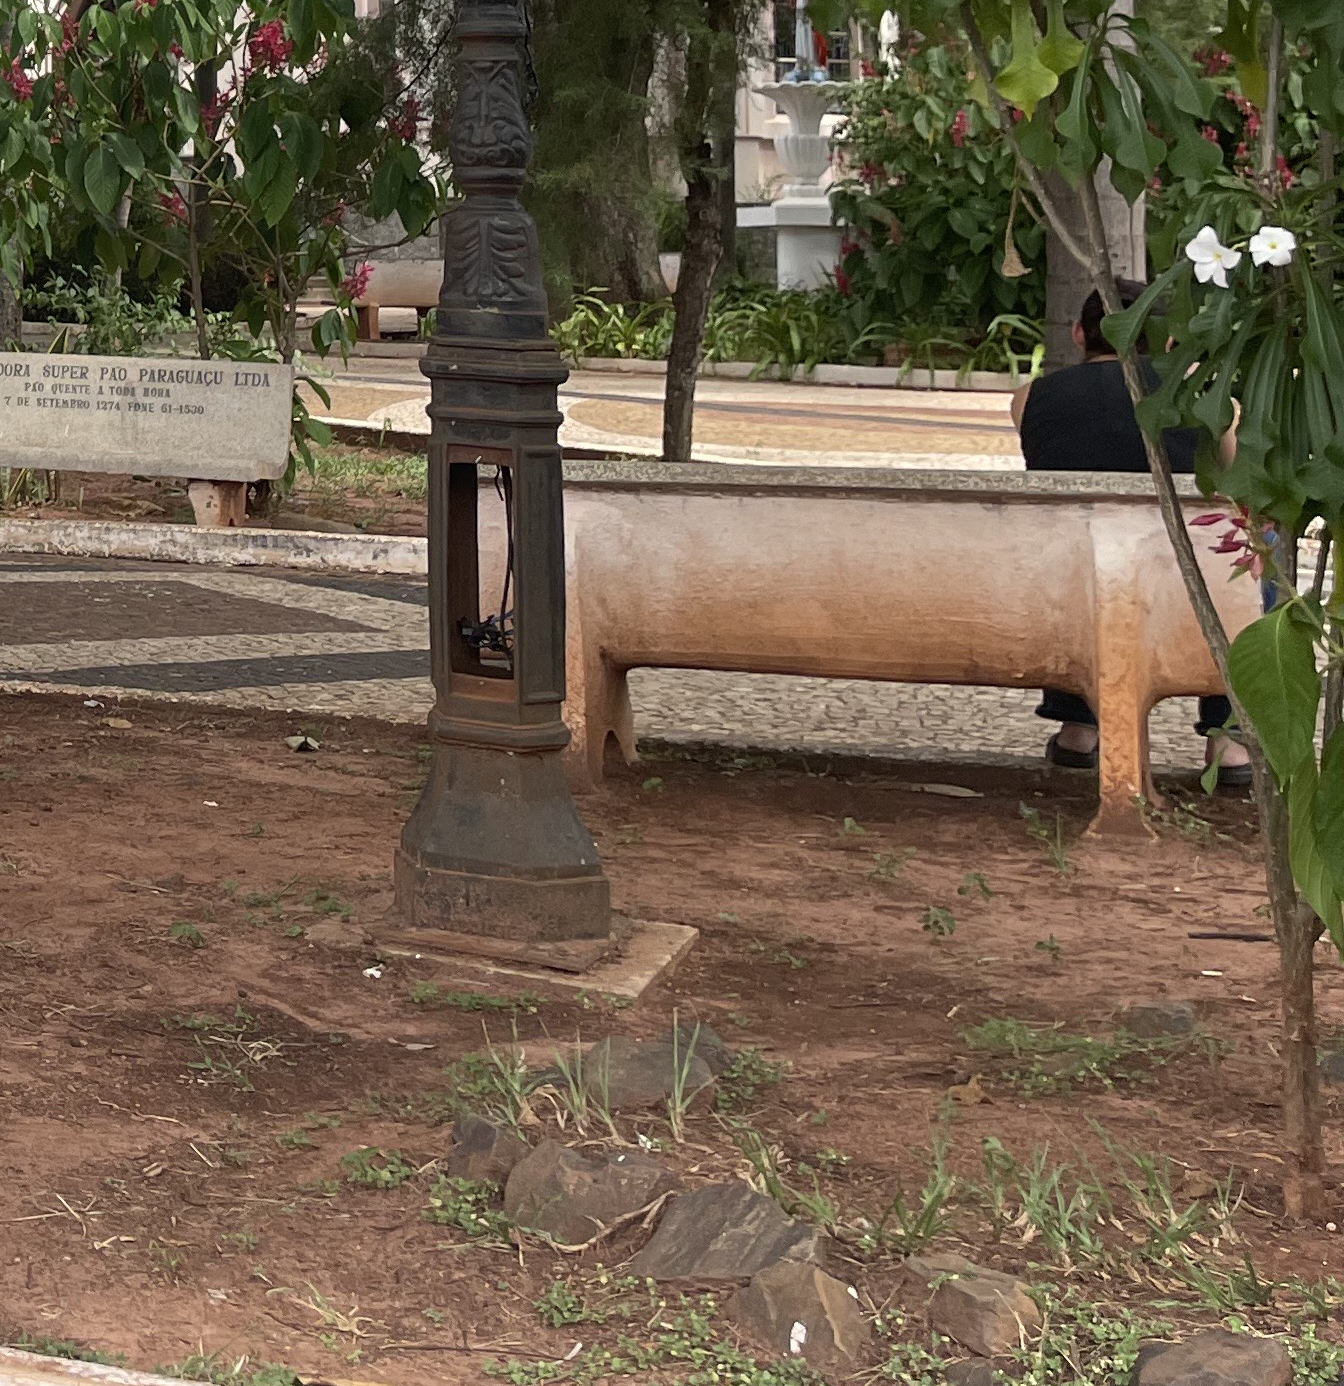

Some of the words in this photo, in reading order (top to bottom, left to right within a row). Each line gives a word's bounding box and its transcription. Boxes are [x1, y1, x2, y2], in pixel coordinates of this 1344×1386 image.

[42, 363, 89, 379] SUPER
[139, 368, 224, 386] PARAGUAÇU
[234, 371, 271, 387] LTDA
[51, 383, 91, 395] QUENTE
[97, 385, 104, 395] A
[109, 386, 136, 397] TODA
[143, 387, 171, 398] HORA
[4, 396, 12, 405] 7
[17, 396, 31, 406] DE
[36, 397, 91, 409] SETEMBRO
[96, 400, 121, 412] 1274
[128, 402, 154, 413] FONE
